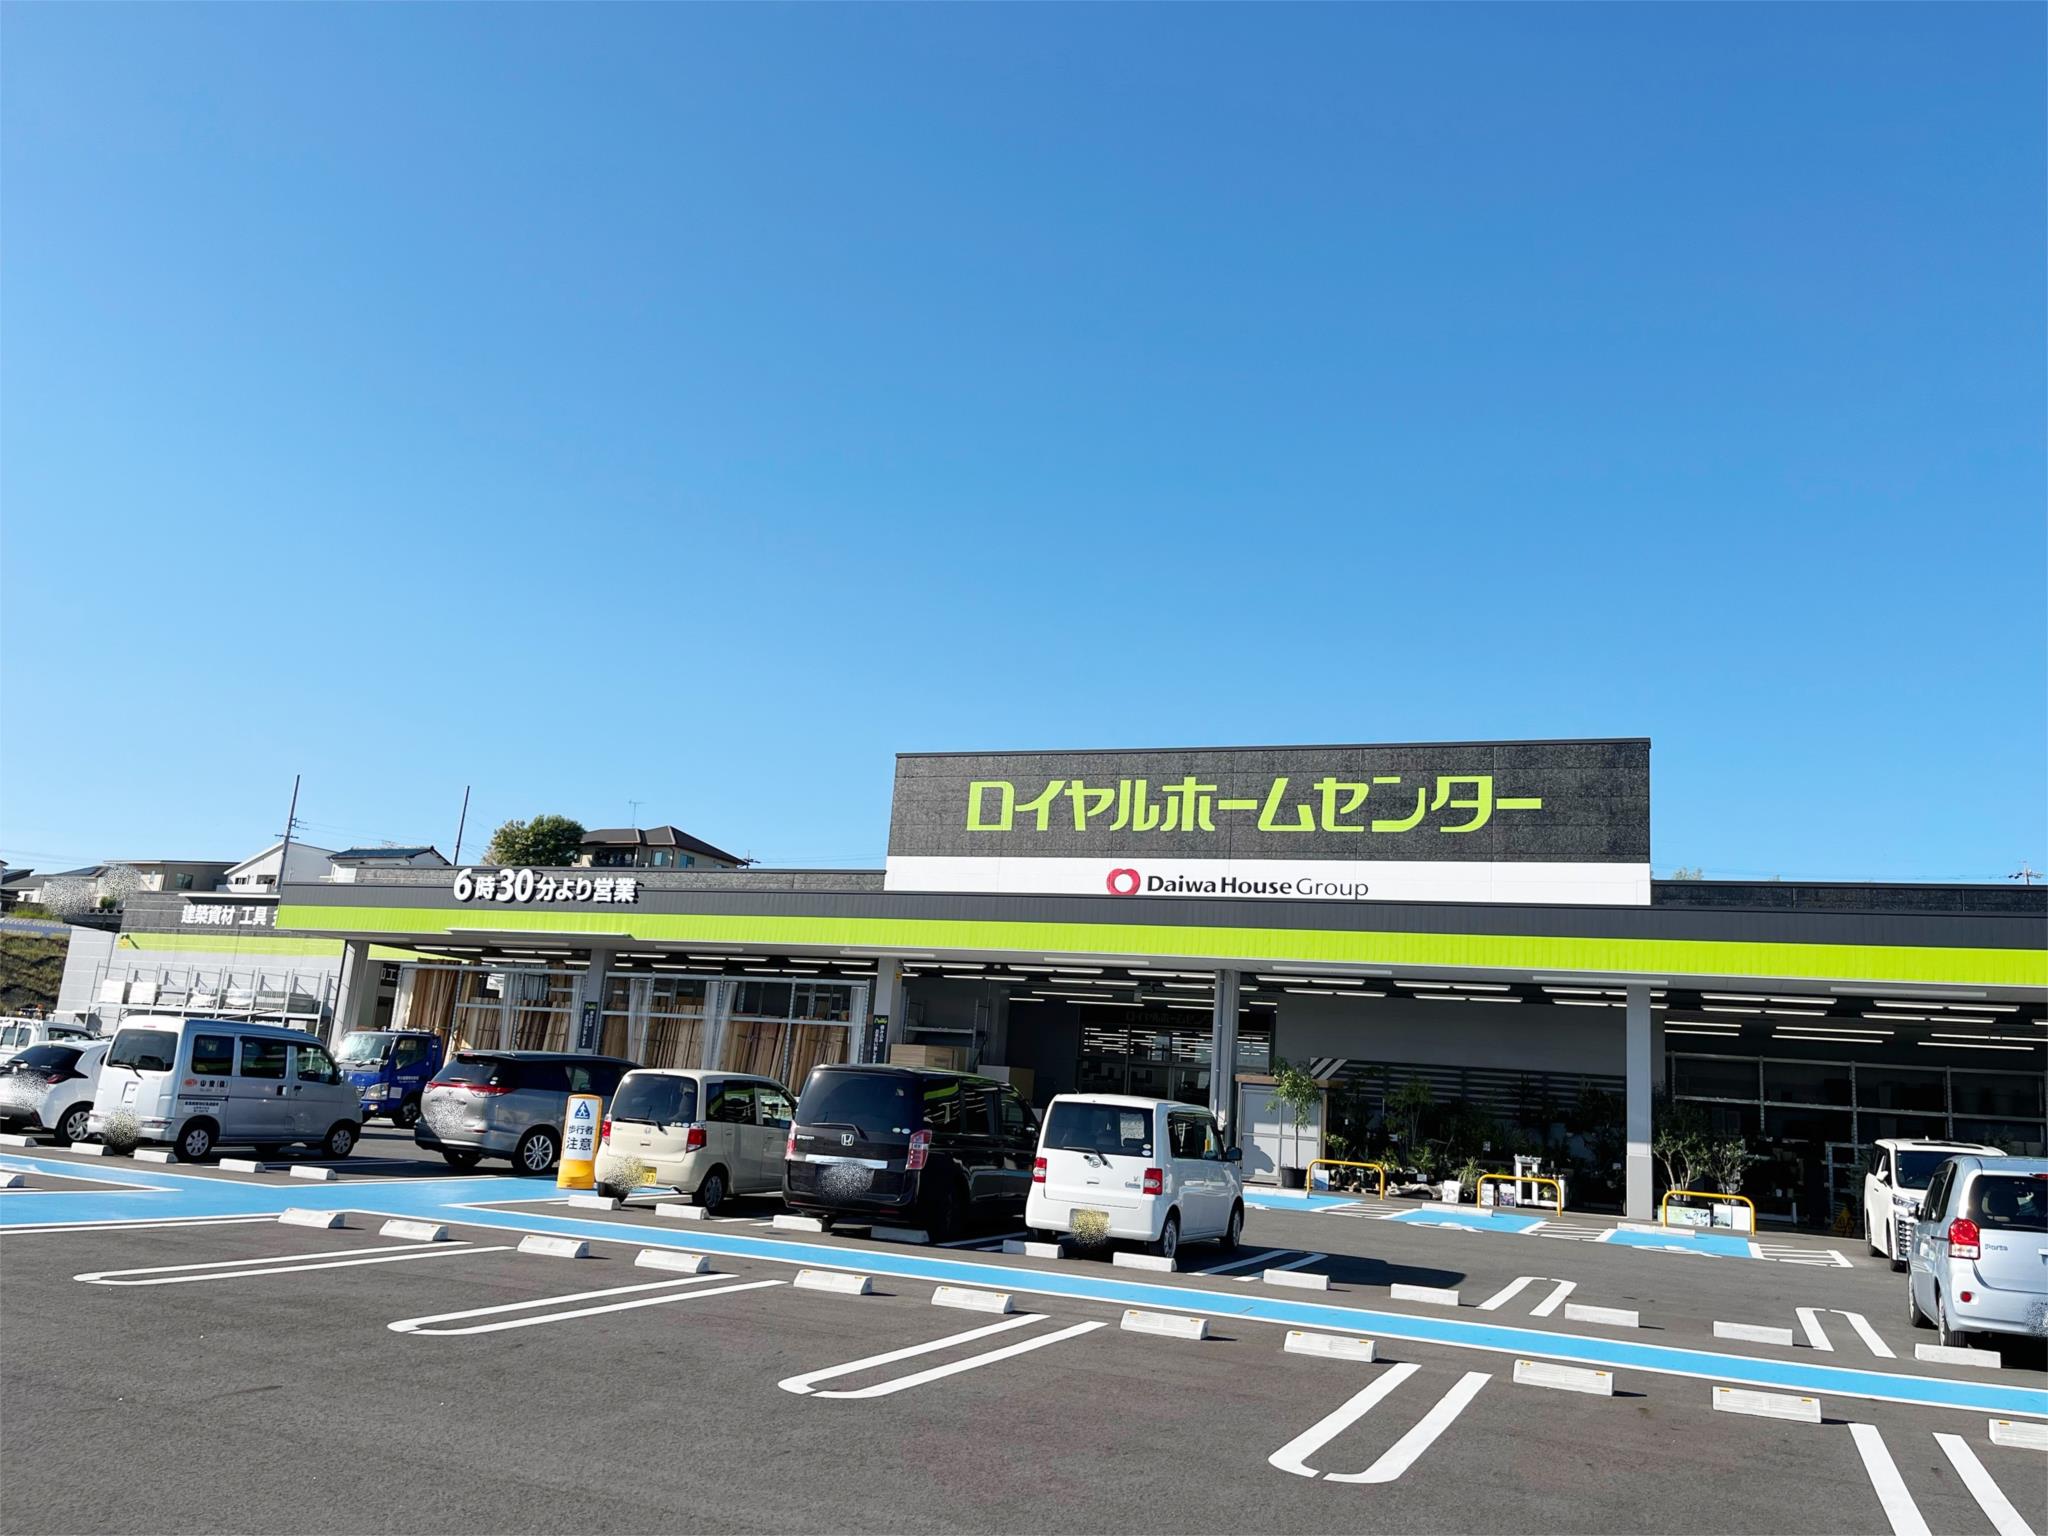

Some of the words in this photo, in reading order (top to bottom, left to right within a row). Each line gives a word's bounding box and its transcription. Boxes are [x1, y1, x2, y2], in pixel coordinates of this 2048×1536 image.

[966, 776, 1542, 832] ロイヤルホームセンター
[453, 868, 637, 902] 6時30分より営業
[1147, 875, 1216, 893] Daiwa
[1221, 877, 1292, 895] House
[1297, 878, 1368, 900] Group
[181, 905, 236, 925] 建築資材
[239, 906, 268, 926] 工具
[568, 1125, 594, 1135] 歩行者
[565, 1137, 592, 1151] 注意
